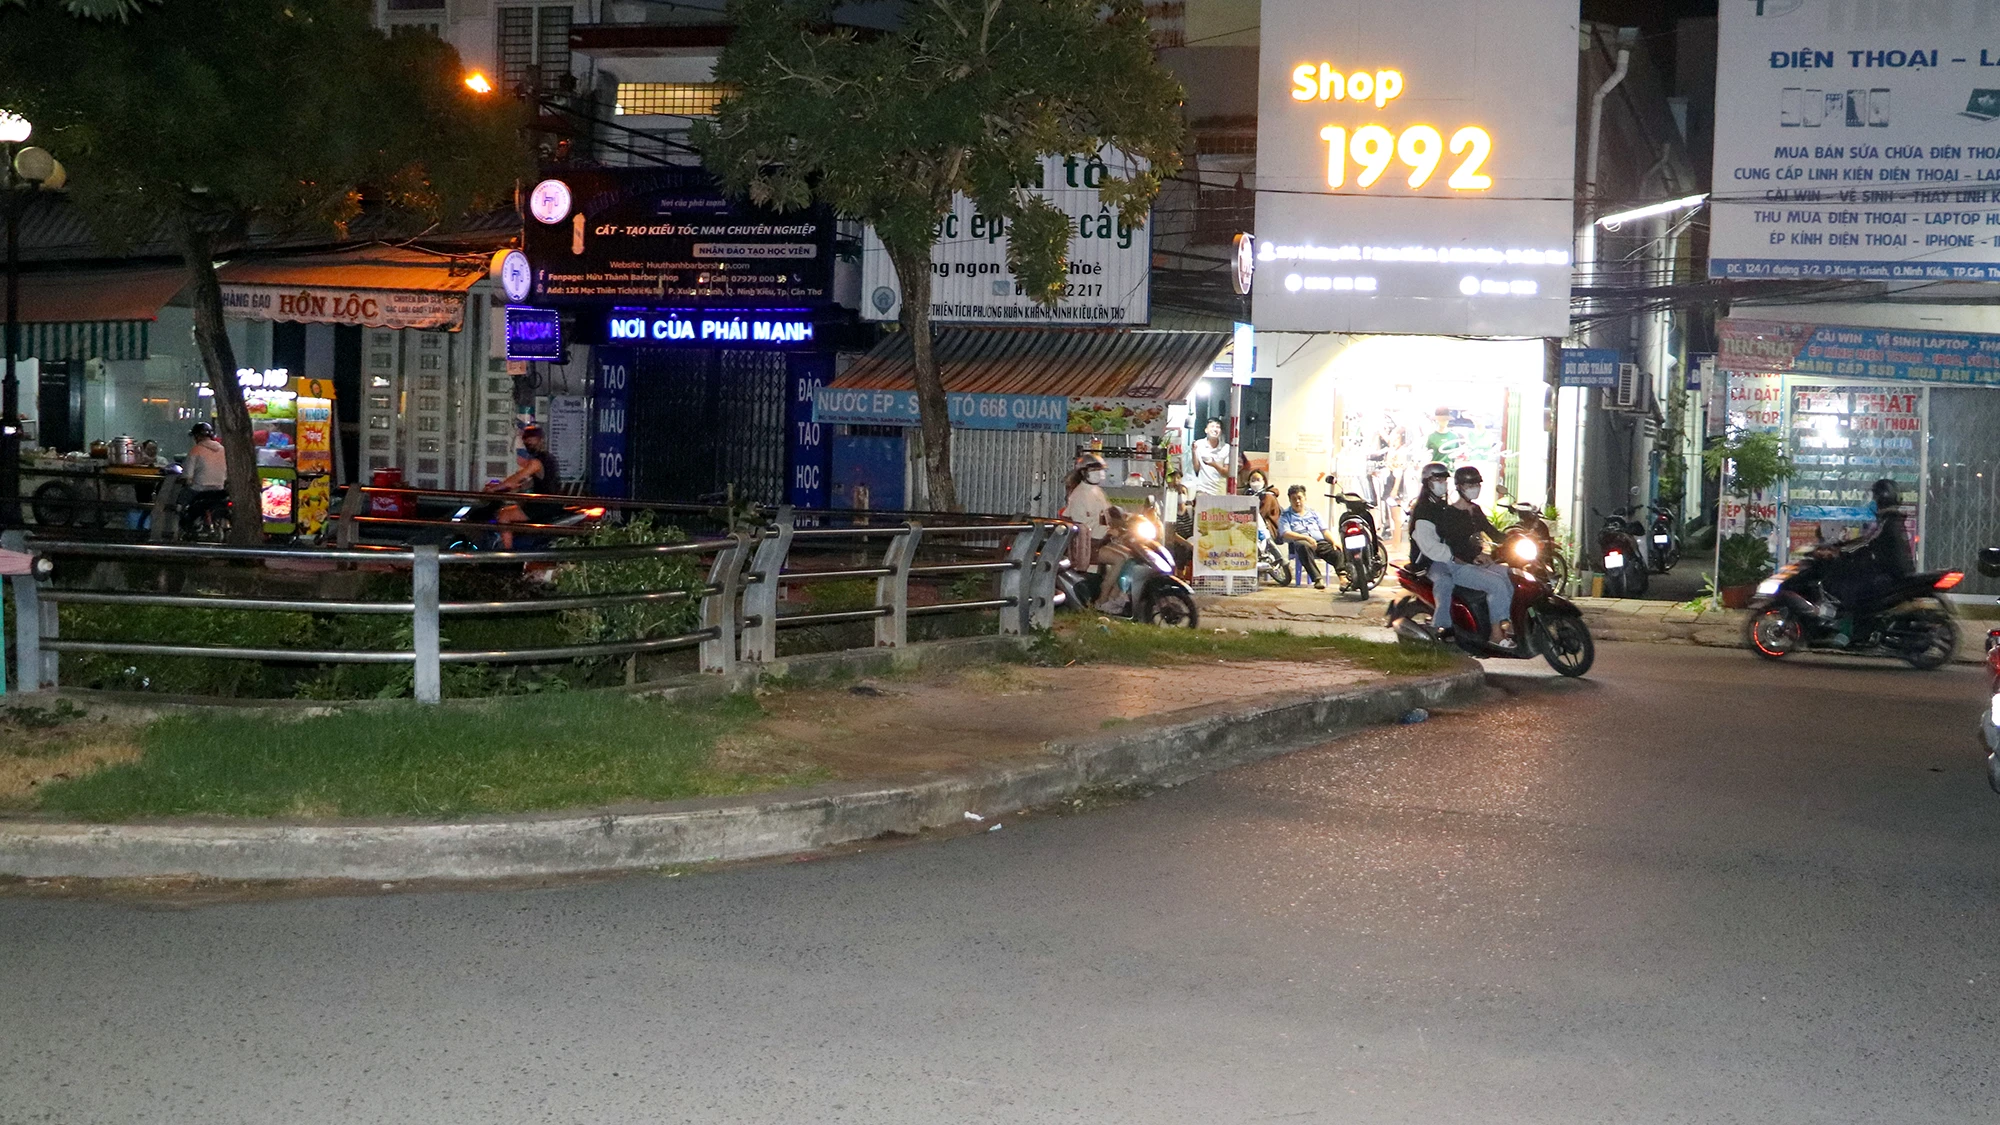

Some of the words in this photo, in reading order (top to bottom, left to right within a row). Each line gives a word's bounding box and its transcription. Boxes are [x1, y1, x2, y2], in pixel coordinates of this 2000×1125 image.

[1768, 48, 1834, 72] ĐIỆN
[1847, 49, 1938, 72] THOẠI
[1291, 62, 1403, 110] Shop
[1319, 124, 1493, 190] 1992
[1774, 146, 1809, 159] MUA
[1815, 143, 1844, 158] BÁN
[1849, 143, 1879, 159] SỬA
[1885, 144, 1924, 159] CHỮA
[1930, 144, 1961, 162] ĐIỆN
[1734, 168, 1770, 180] CUNG
[1776, 164, 1803, 180] CẤP
[1808, 168, 1838, 180] LINH
[1843, 166, 1874, 182] KIỆN
[1879, 166, 1910, 182] ĐIỆN
[1916, 168, 1959, 183] THOẠI
[1794, 190, 1821, 202] WIN
[1862, 191, 1894, 202] SINH
[1913, 190, 1949, 203] THAY
[1956, 190, 1986, 203] LINH
[1754, 211, 1782, 222] THU
[1787, 211, 1822, 224] MUA
[1828, 209, 1858, 226] ĐIỆN
[1864, 212, 1907, 227] THOẠI
[1925, 213, 1981, 226] LAPTOP
[595, 224, 618, 235] CẮT
[626, 226, 648, 238] TẠO
[678, 224, 699, 236] TÓC
[700, 225, 725, 235] NAM
[727, 224, 772, 235] CHUYÊN
[774, 223, 816, 237] NGHIỆP
[1770, 230, 1786, 244] ÉP
[1791, 230, 1822, 245] KÍNH
[1829, 231, 1859, 248] ĐIỆN
[1865, 234, 1907, 249] THOẠI
[1926, 234, 1975, 247] IPHONE
[748, 247, 765, 257] TẠO
[768, 247, 786, 257] HỌC
[788, 244, 810, 254] VIÊN
[610, 261, 644, 269] Website:
[956, 262, 1000, 278] ngon
[1726, 264, 1742, 274] ĐC:
[548, 273, 584, 282] Fanpage:
[630, 273, 658, 282] Barber
[659, 274, 679, 283] shop
[546, 286, 564, 294] Add:
[223, 289, 250, 308] HÀNG
[252, 294, 272, 312] GẠO
[332, 292, 379, 320] LỘC
[932, 300, 954, 316] THIÊN
[955, 302, 972, 318] TÍCH
[973, 304, 1002, 319] PHƯỜNG
[1004, 302, 1023, 319] XUÂN
[610, 318, 646, 338] NƠI
[652, 313, 695, 340] CỦA
[702, 316, 748, 340] PHÁI
[753, 321, 814, 344] MẠNH
[1816, 330, 1836, 342] CÀI
[1838, 332, 1862, 344] WIN
[1892, 336, 1920, 348] SINH
[1924, 338, 1969, 350] LAPTOP
[602, 364, 626, 394] TẠO
[818, 388, 868, 412] NƯỚC
[872, 389, 894, 414] ÉP
[980, 398, 1008, 418] 668
[1012, 395, 1061, 420] QUÁN
[798, 421, 820, 450] TẠO
[599, 446, 622, 478] TÓC
[796, 464, 820, 494] HỌC
